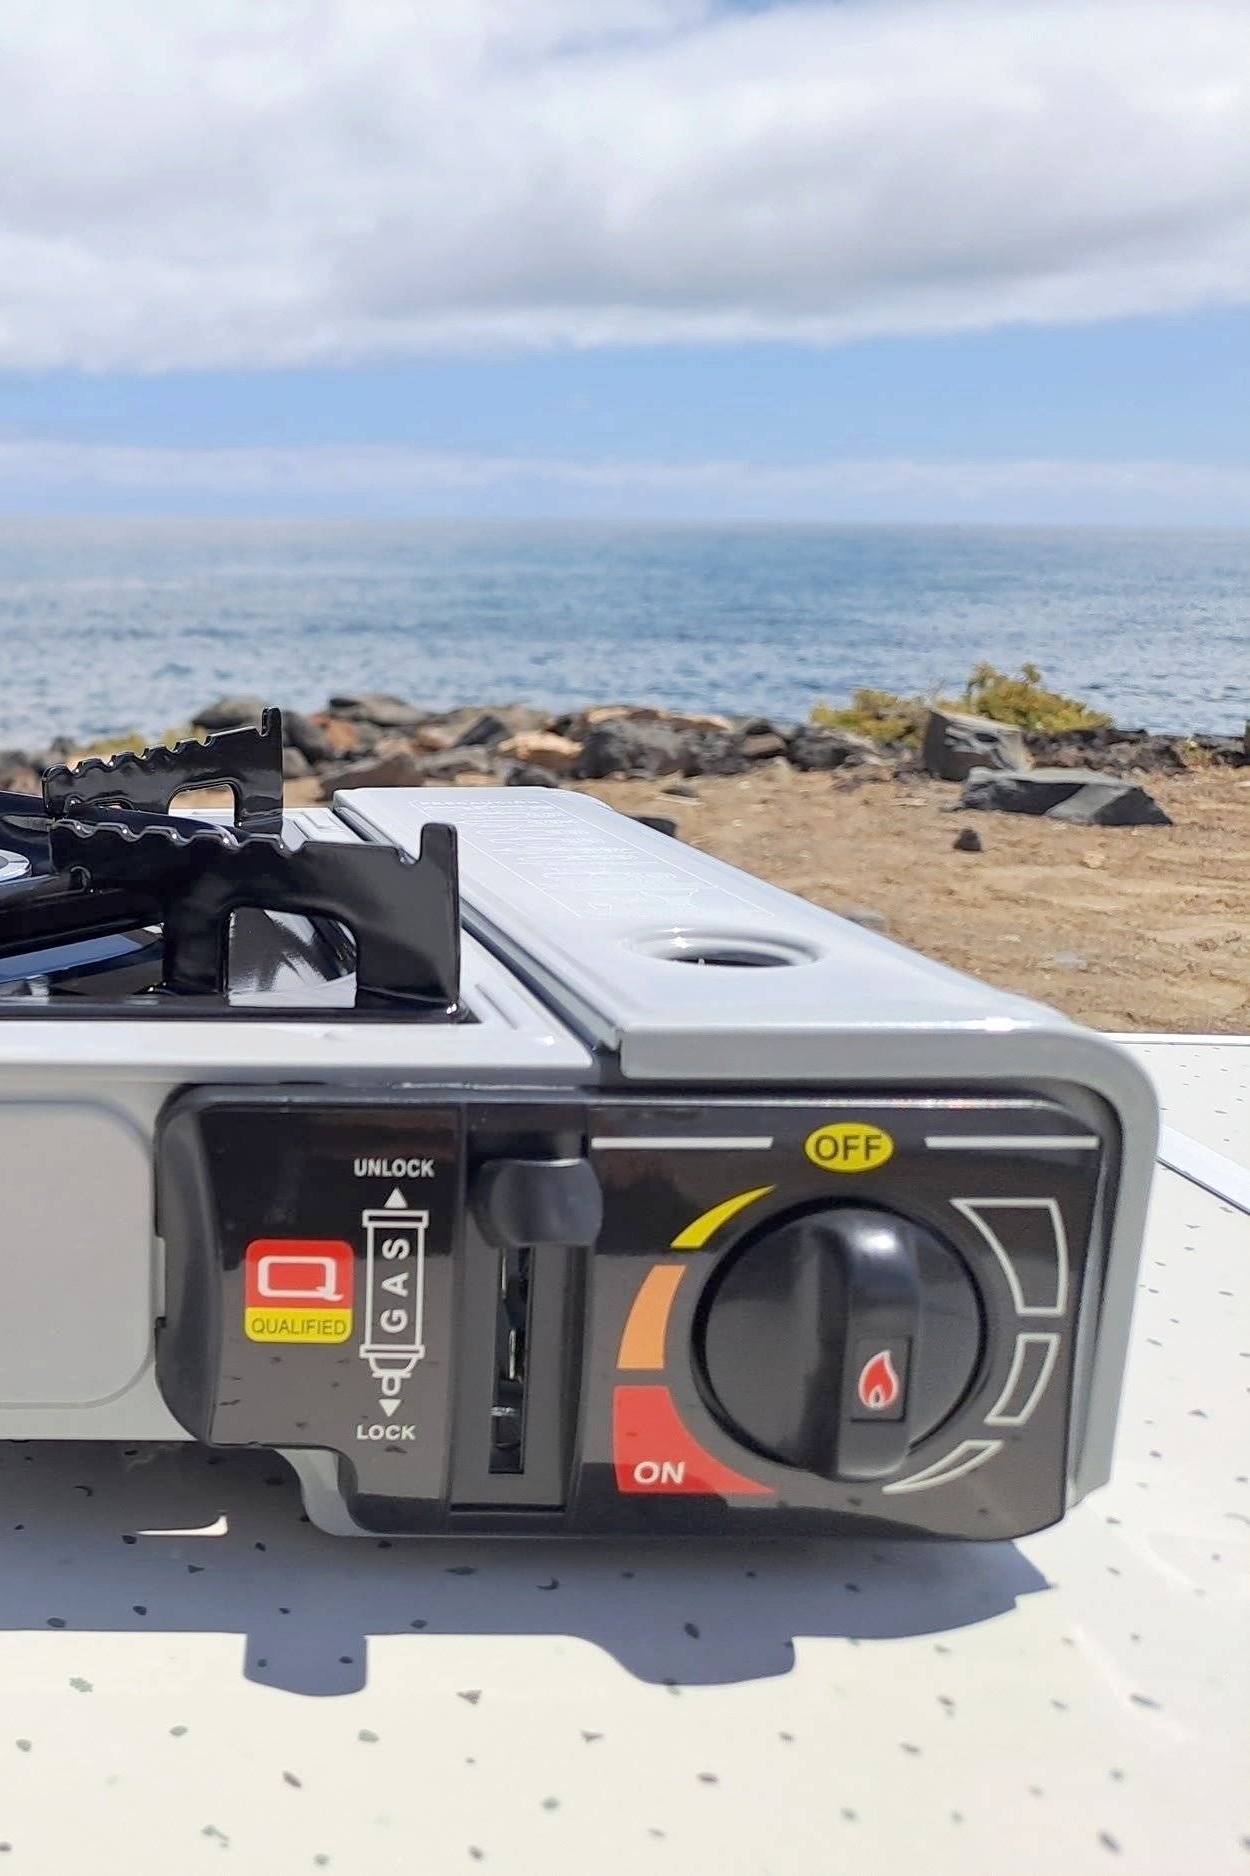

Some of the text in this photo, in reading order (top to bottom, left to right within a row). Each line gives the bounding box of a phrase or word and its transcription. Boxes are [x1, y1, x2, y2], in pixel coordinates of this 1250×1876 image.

[814, 1134, 883, 1162] OFF
[354, 1158, 435, 1178] UNLOCK
[380, 1237, 410, 1334] GAS
[251, 1317, 347, 1336] QUALIFIED
[356, 1424, 416, 1441] LOCK
[633, 1460, 686, 1485] ON
